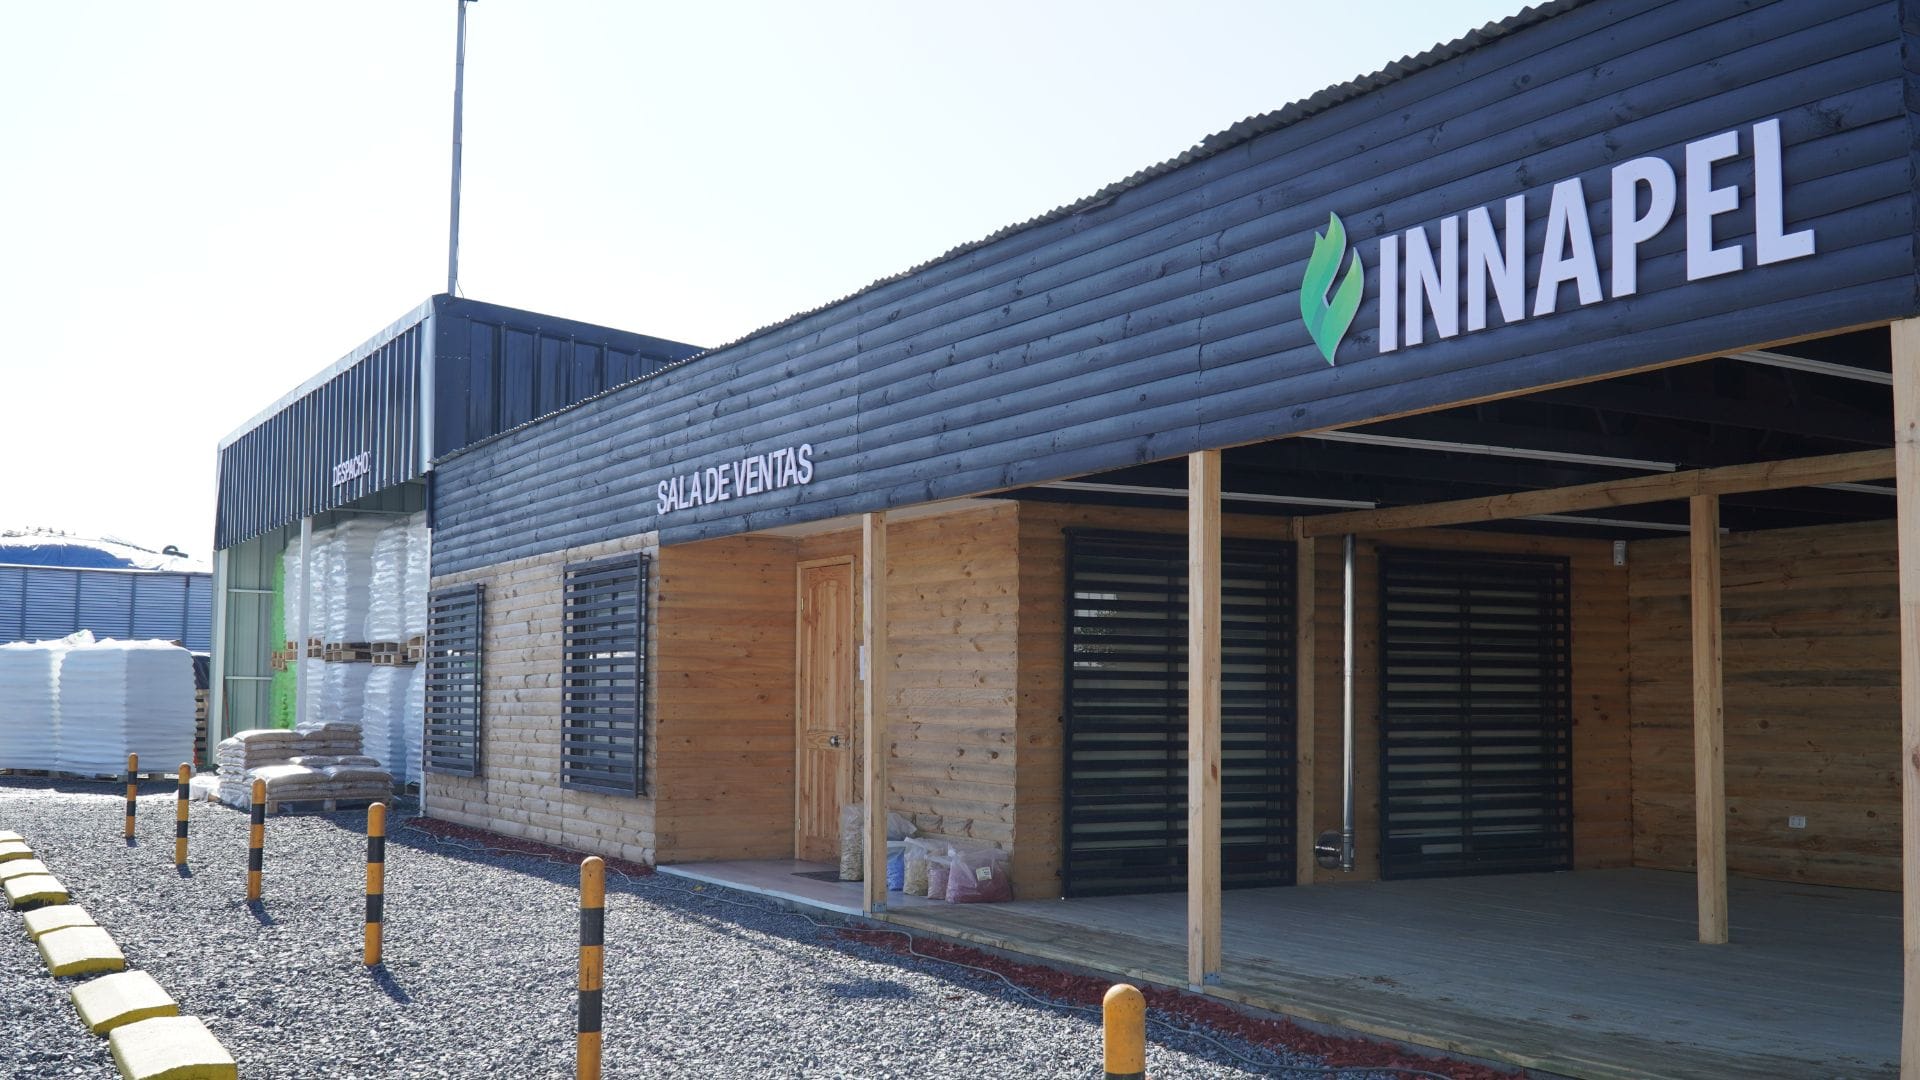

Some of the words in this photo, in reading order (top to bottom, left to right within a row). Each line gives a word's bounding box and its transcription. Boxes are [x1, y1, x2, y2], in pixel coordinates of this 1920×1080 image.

[1379, 118, 1815, 353] INNAPEL
[332, 451, 369, 487] DESPACHO
[656, 471, 703, 515] SALA
[705, 463, 731, 504] DE
[733, 443, 814, 498] VENTAS
